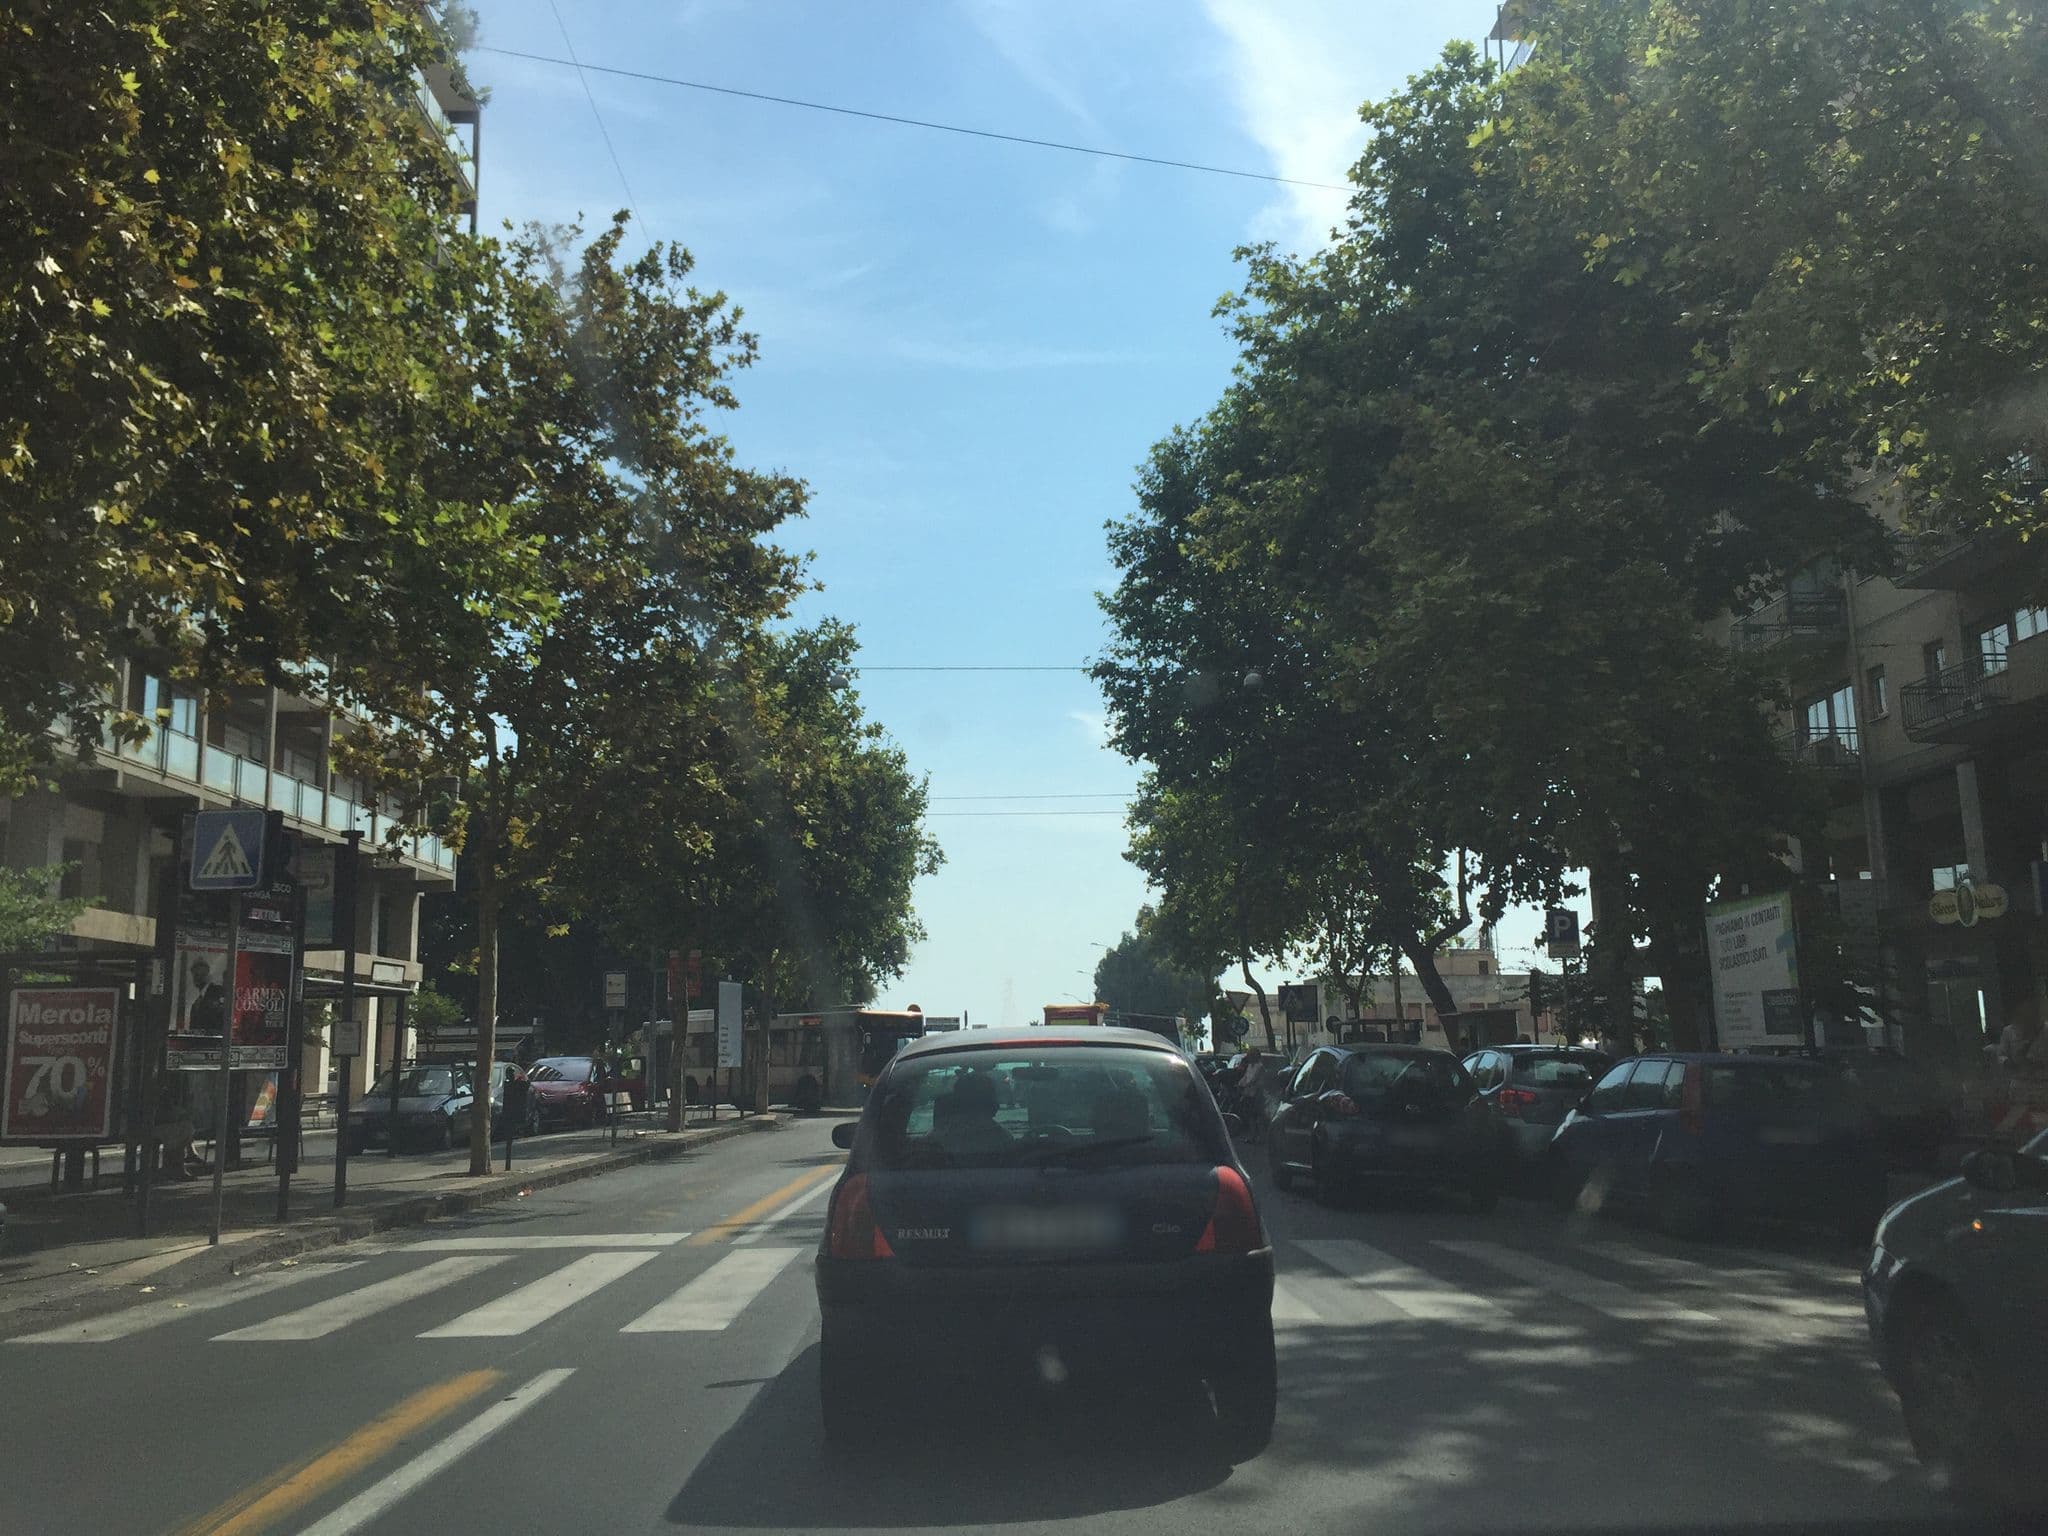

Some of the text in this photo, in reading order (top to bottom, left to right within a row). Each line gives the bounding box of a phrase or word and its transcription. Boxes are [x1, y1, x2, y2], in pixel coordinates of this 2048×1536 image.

[1553, 915, 1573, 938] P
[236, 986, 286, 1001] CARMEN
[17, 1003, 112, 1025] Merola
[235, 999, 285, 1013] CONSOLI
[18, 1029, 108, 1049] Supersconti
[897, 1225, 952, 1240] RENAULT
